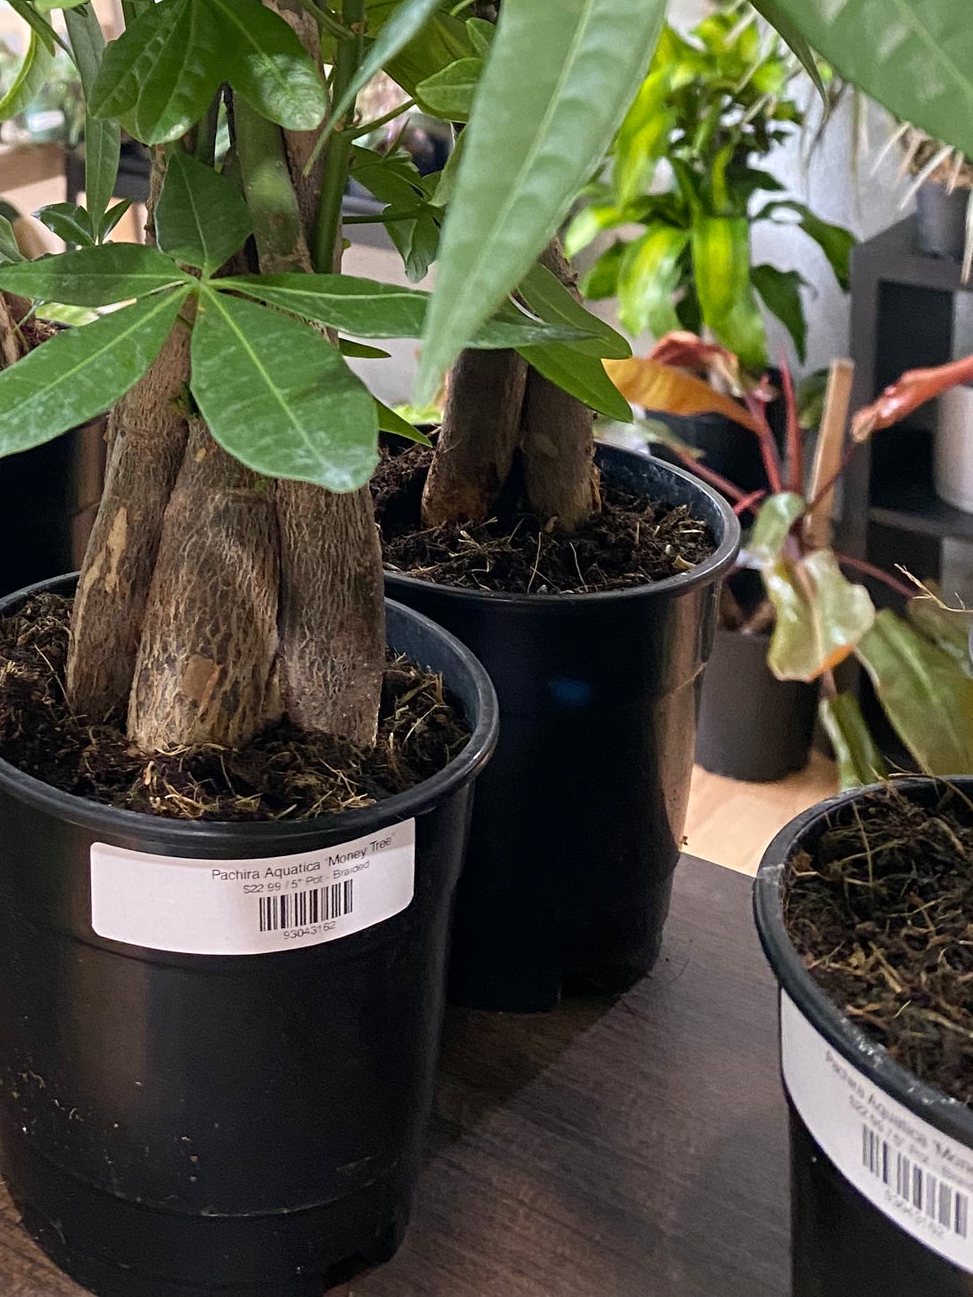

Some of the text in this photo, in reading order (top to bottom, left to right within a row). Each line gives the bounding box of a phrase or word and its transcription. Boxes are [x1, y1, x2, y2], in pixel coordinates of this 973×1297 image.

[211, 868, 260, 881] Pachira
[264, 861, 321, 878] Aquatica
[333, 860, 370, 880] Braided
